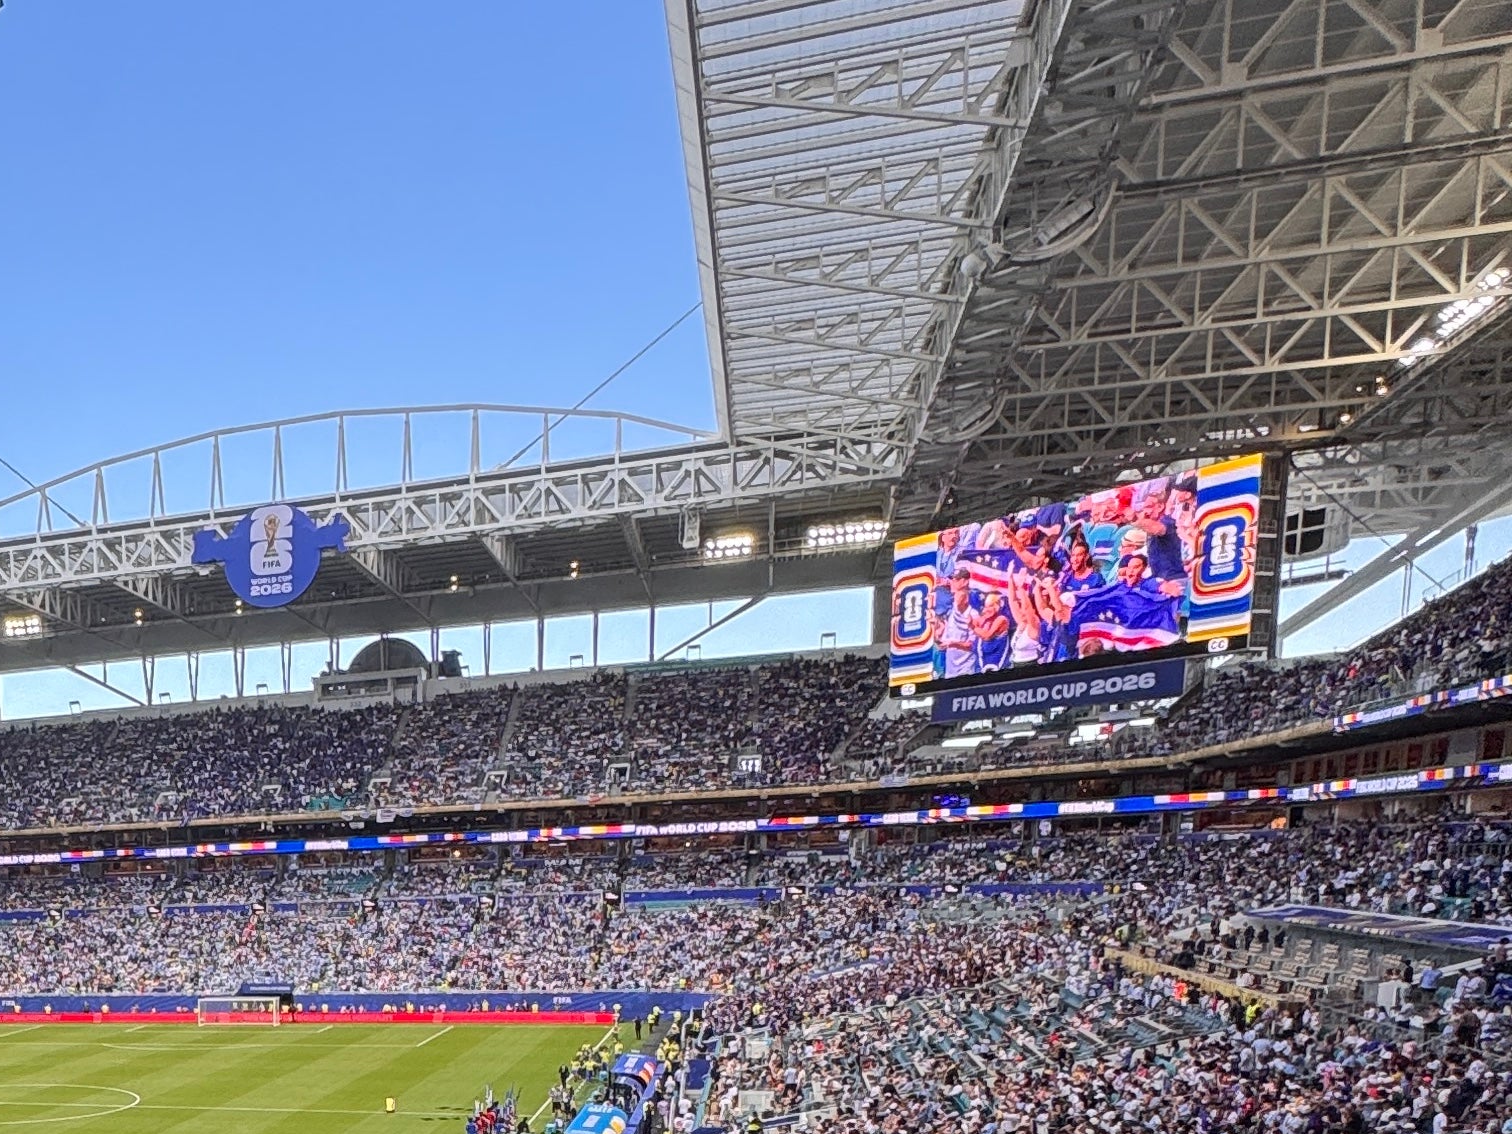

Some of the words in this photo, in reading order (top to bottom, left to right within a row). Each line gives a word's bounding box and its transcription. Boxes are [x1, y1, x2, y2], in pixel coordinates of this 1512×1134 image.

[262, 560, 281, 569] FIFA
[250, 576, 277, 585] WORLD
[277, 574, 293, 583] CUP
[250, 582, 293, 597] 2026
[952, 694, 986, 712] FIFA
[988, 687, 1050, 708] WORLD
[1051, 682, 1087, 701] CUP
[1089, 672, 1156, 697] 2026
[635, 825, 658, 836] FIFA
[659, 823, 696, 834] WORLD
[696, 821, 718, 832] CUP
